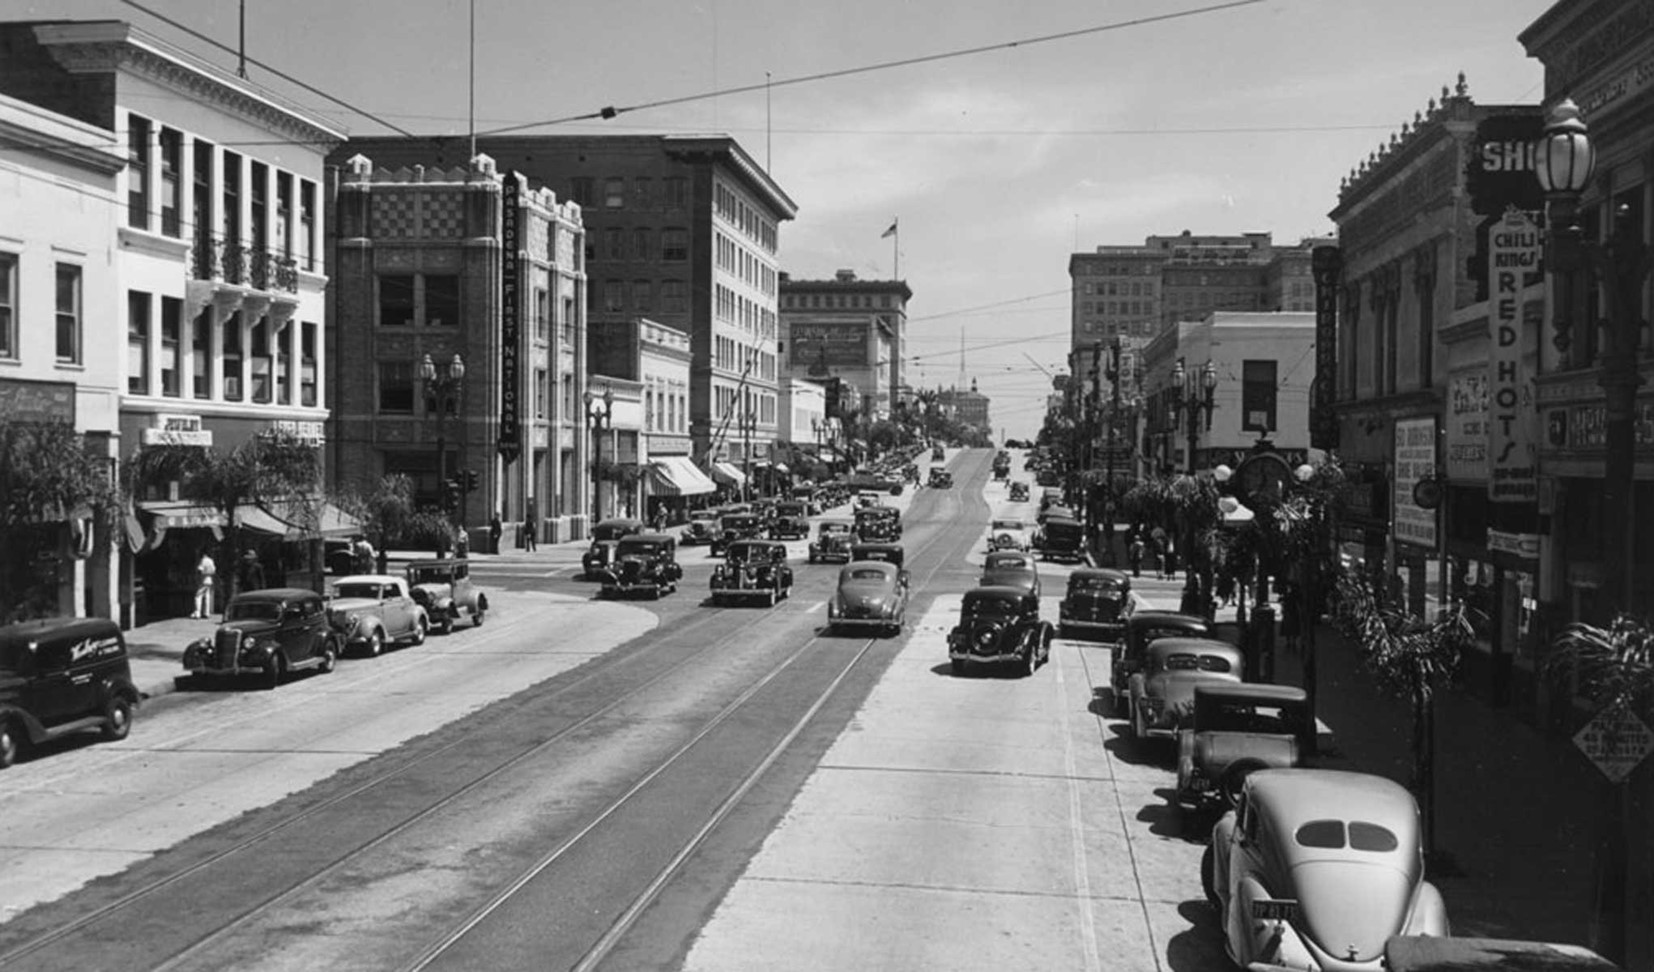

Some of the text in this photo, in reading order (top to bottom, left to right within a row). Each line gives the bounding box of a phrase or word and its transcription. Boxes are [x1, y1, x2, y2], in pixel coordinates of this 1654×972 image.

[1495, 233, 1534, 247] CHILI
[1499, 272, 1516, 347] RED
[504, 345, 515, 434] NATIONAL
[1497, 360, 1517, 463] HOTS
